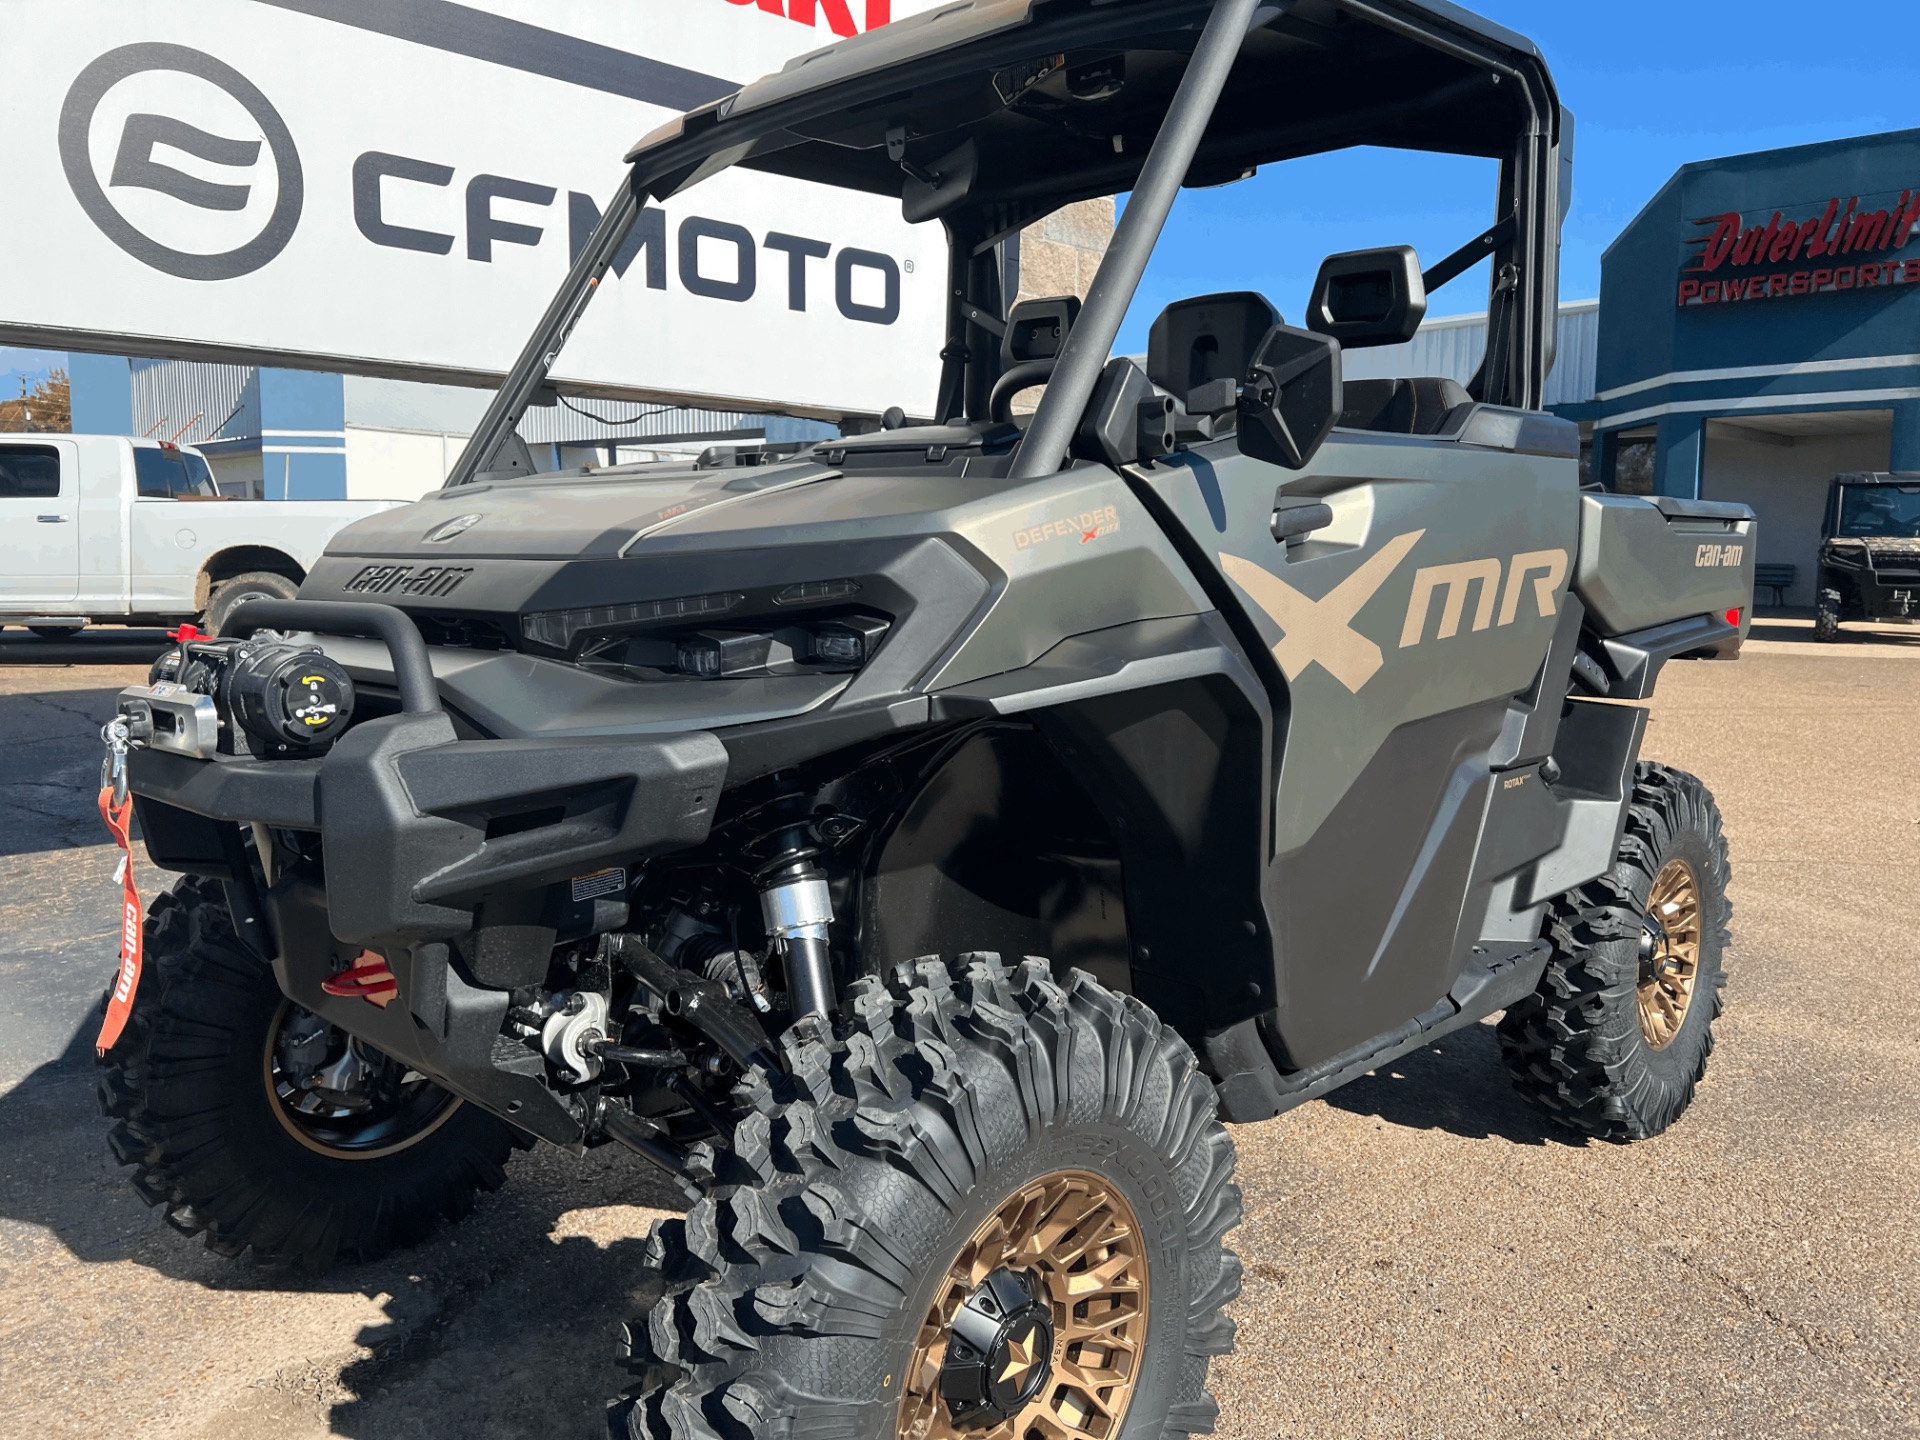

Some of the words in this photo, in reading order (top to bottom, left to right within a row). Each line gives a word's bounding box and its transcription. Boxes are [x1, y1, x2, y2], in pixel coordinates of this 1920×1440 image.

[352, 150, 901, 326] CFMOTO
[1678, 258, 1920, 307] POWERSPORTS
[1012, 504, 1117, 549] DEFENDER
